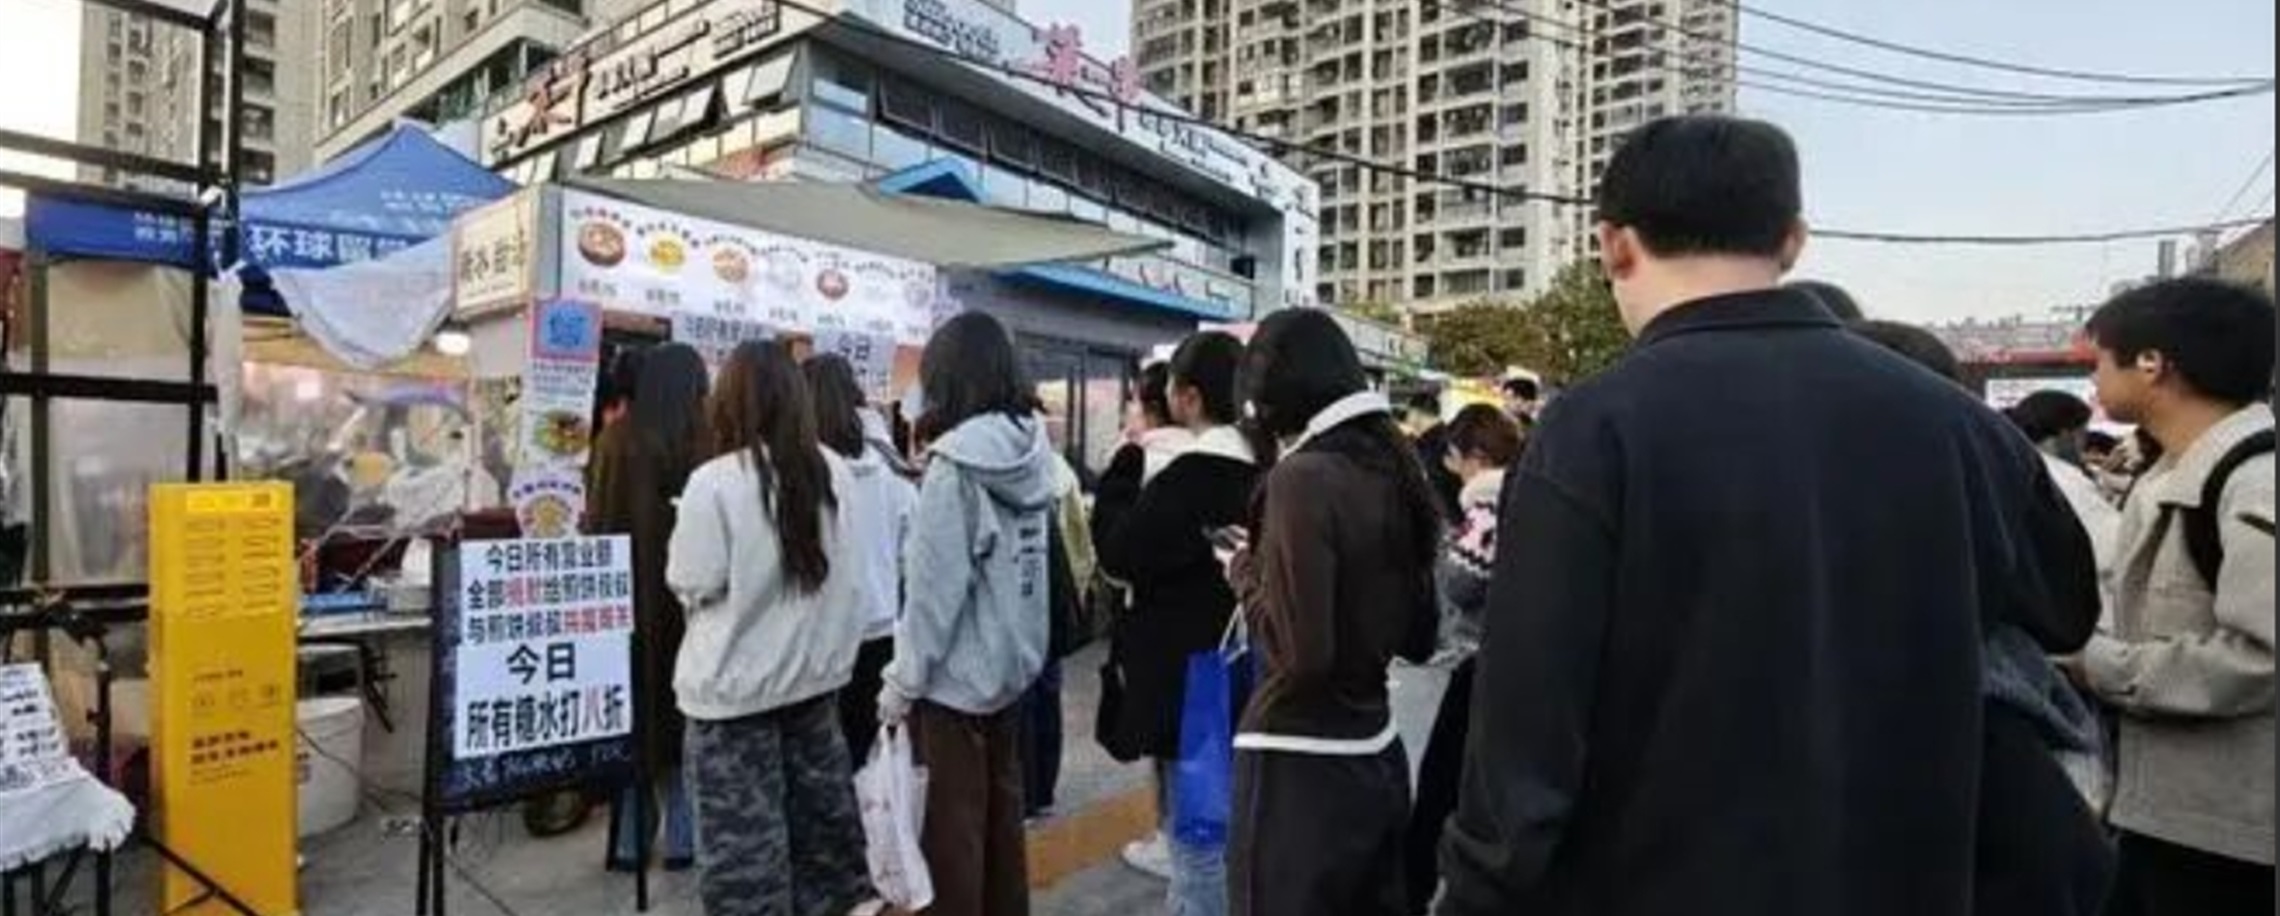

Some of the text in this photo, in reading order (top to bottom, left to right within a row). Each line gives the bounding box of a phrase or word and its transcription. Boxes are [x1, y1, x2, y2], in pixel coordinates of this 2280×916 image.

[486, 539, 612, 573] 今日所有营业额
[507, 642, 576, 685] 今日
[467, 685, 623, 748] 所有糖水打八折
